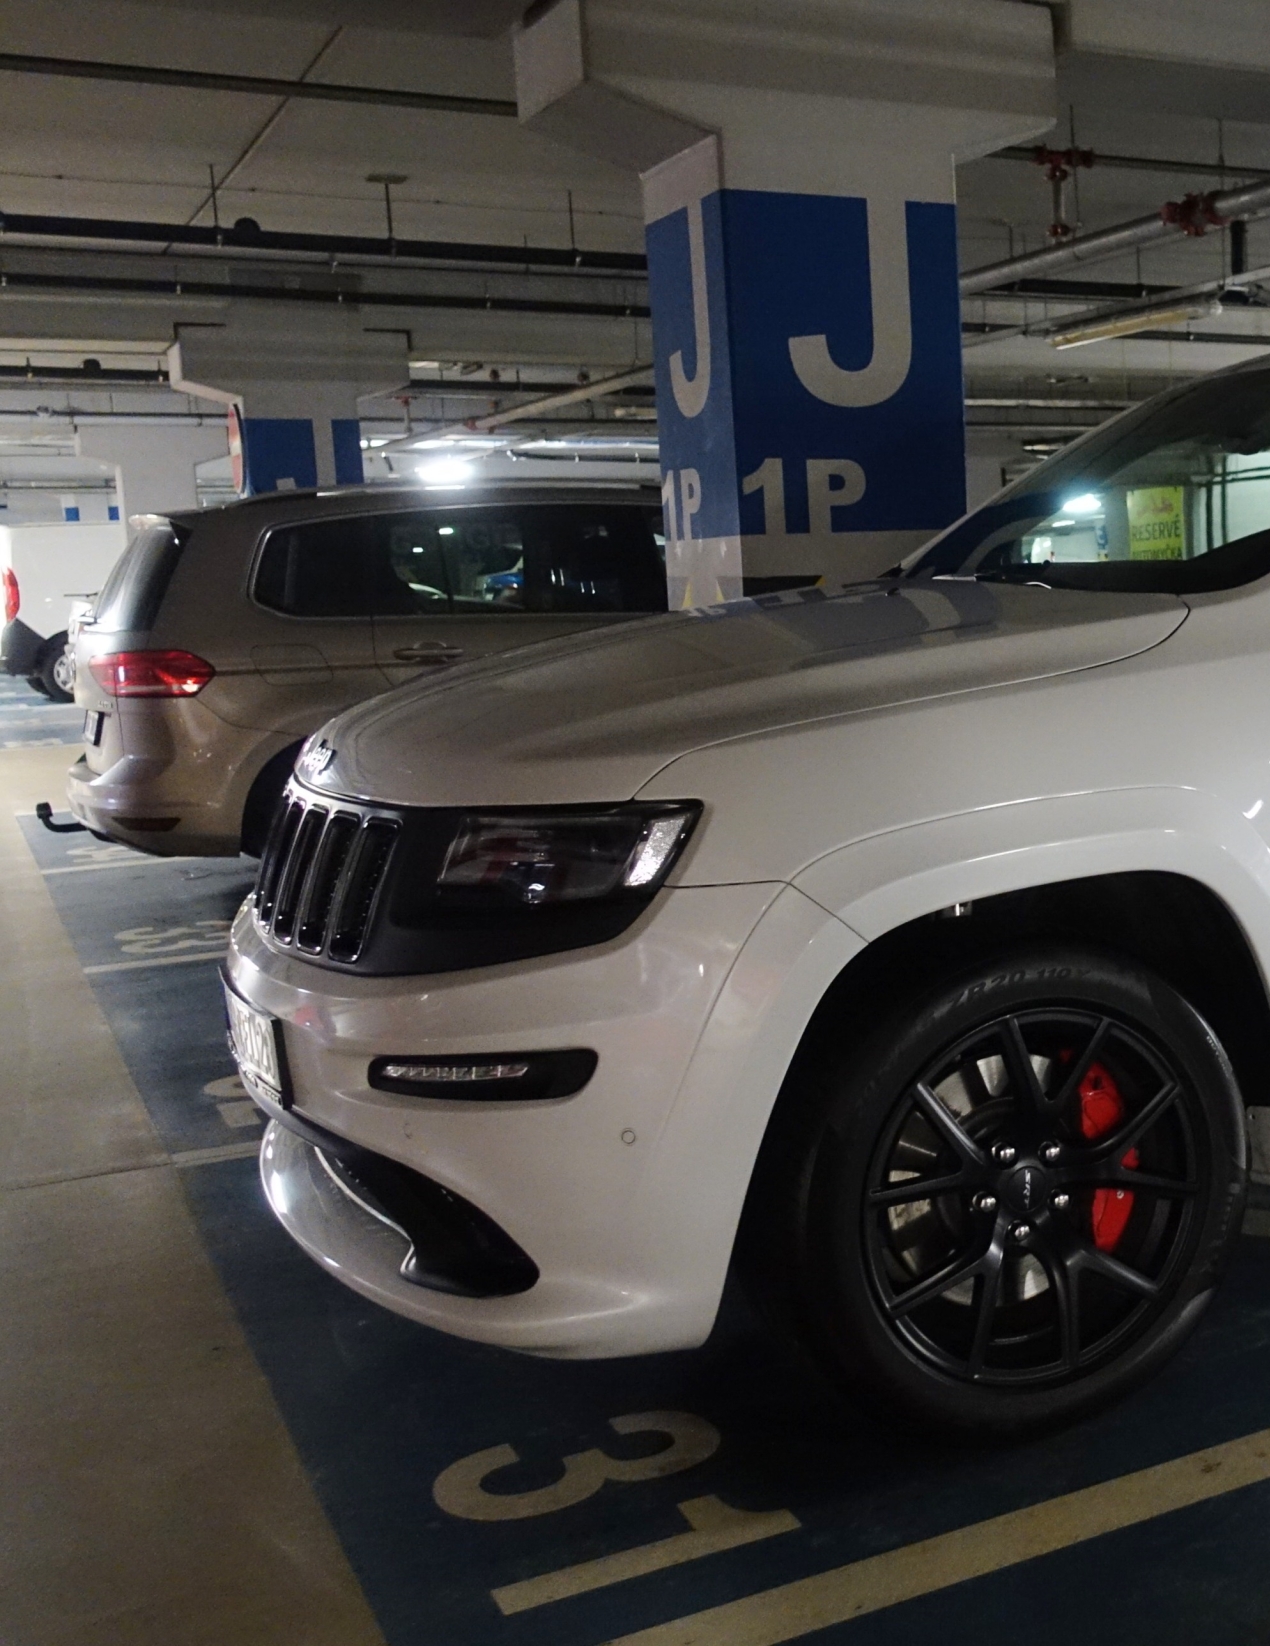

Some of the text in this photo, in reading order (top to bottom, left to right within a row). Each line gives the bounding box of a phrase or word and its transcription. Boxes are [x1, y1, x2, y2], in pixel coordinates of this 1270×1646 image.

[669, 200, 711, 418] J
[788, 198, 912, 408] J
[660, 467, 701, 541] 1P
[742, 457, 866, 535] 1P
[1131, 513, 1181, 541] RESERVÉ
[432, 1409, 802, 1616] 31
